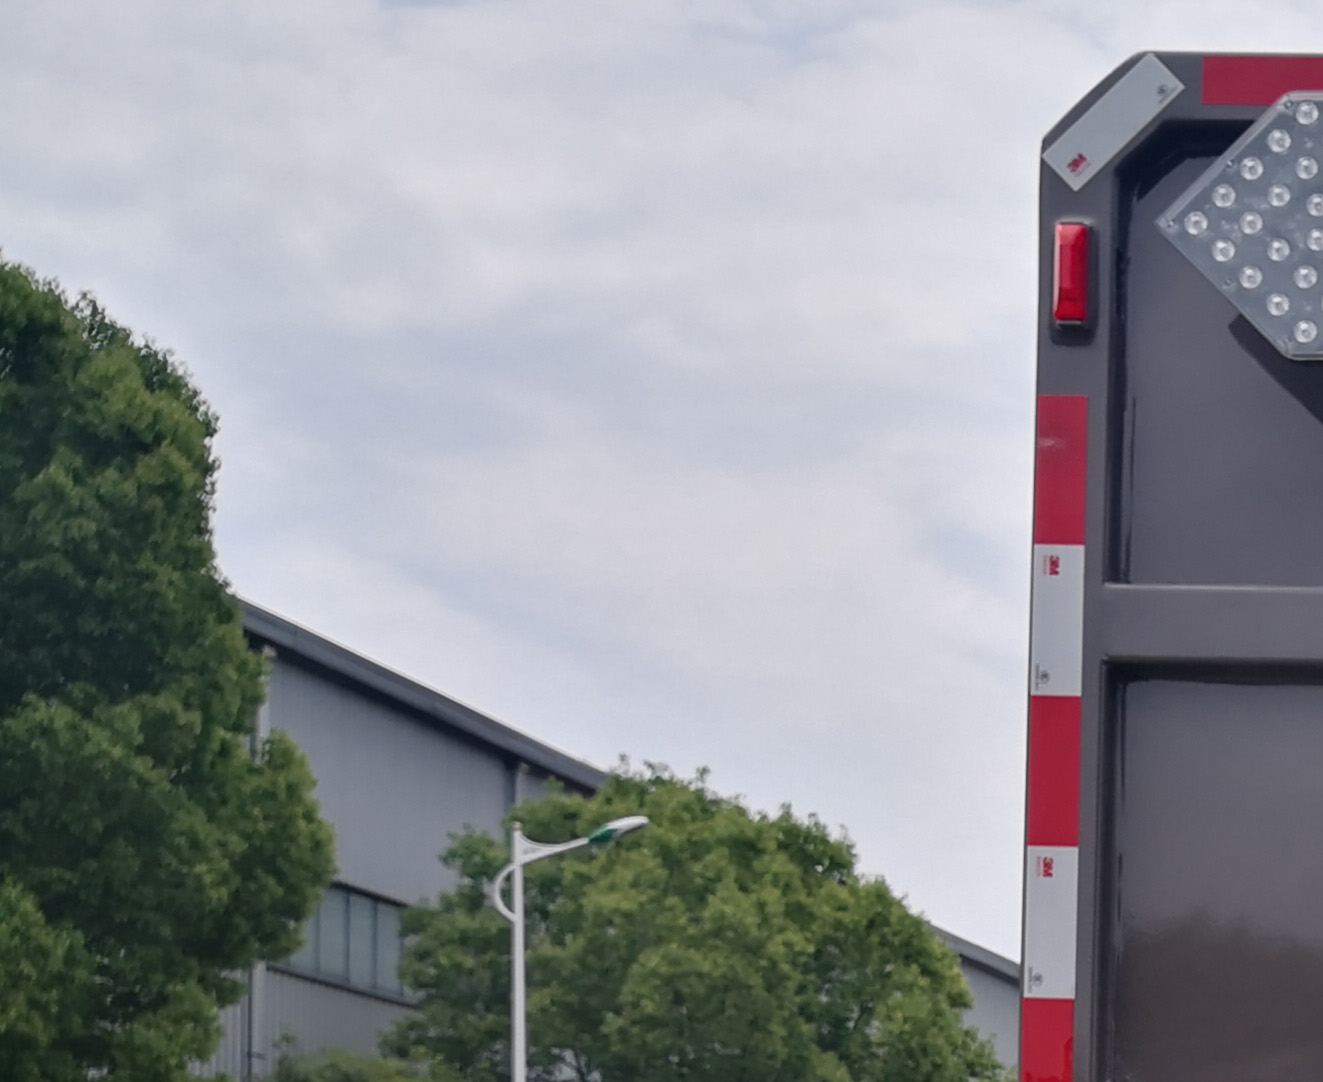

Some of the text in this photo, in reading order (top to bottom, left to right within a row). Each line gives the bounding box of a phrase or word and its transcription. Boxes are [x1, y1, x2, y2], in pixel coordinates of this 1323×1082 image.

[1067, 152, 1087, 172] 3M
[1049, 555, 1060, 576] 3M
[1042, 856, 1054, 878] 3M
